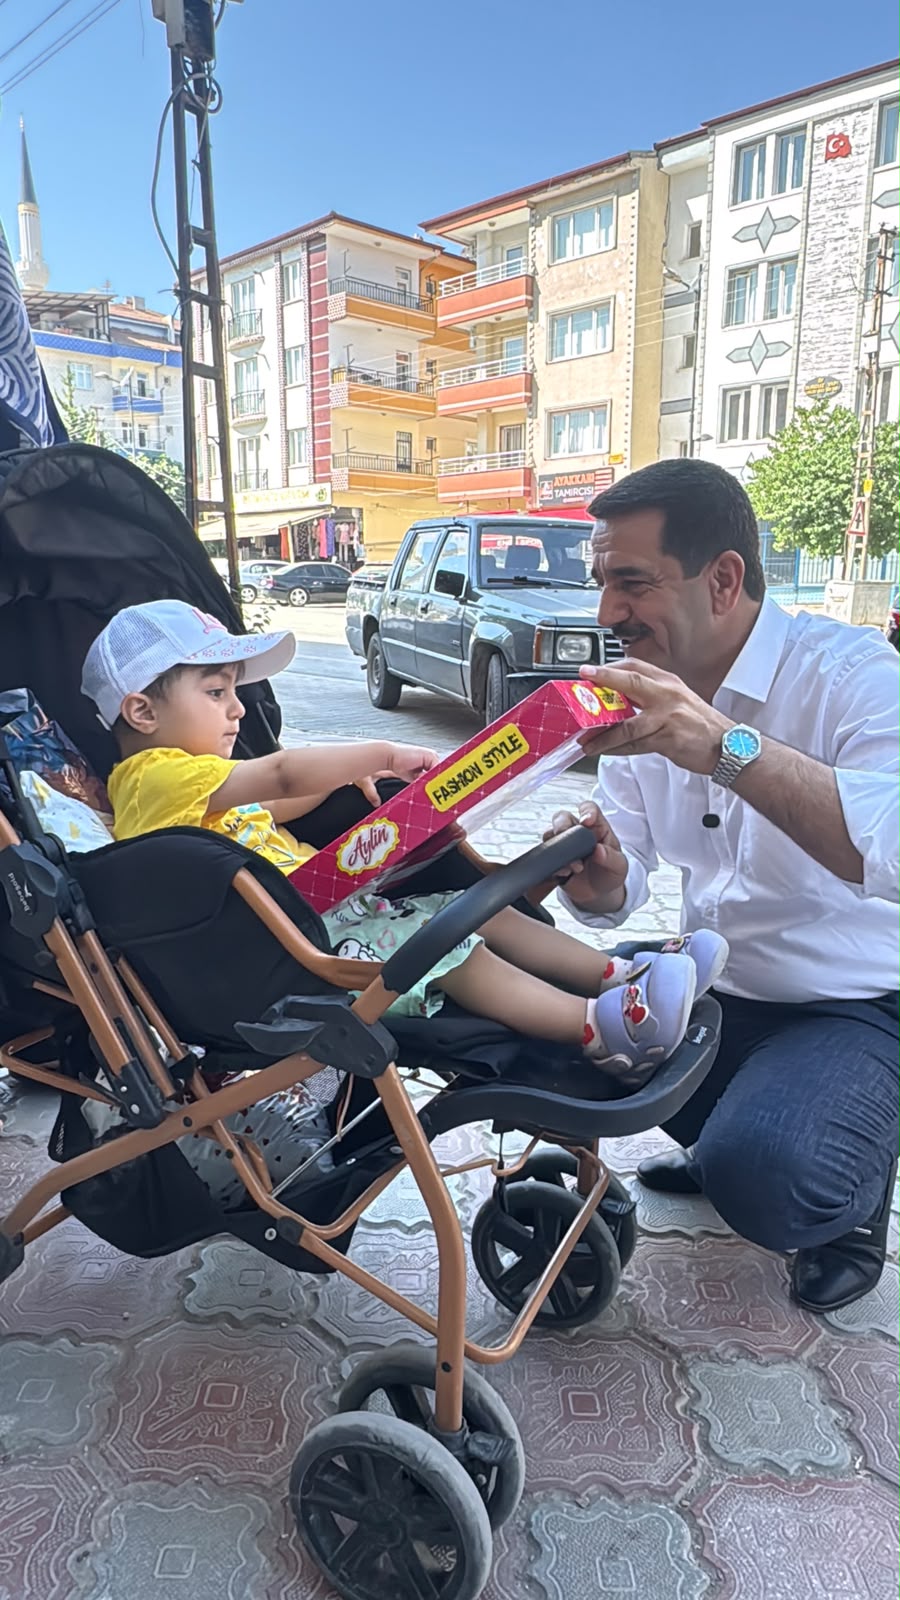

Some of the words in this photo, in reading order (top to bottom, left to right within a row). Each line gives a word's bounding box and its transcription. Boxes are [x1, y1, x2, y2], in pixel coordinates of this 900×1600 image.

[432, 762, 483, 804] FASHION
[481, 733, 523, 769] STYLE
[348, 824, 388, 866] Aylin
